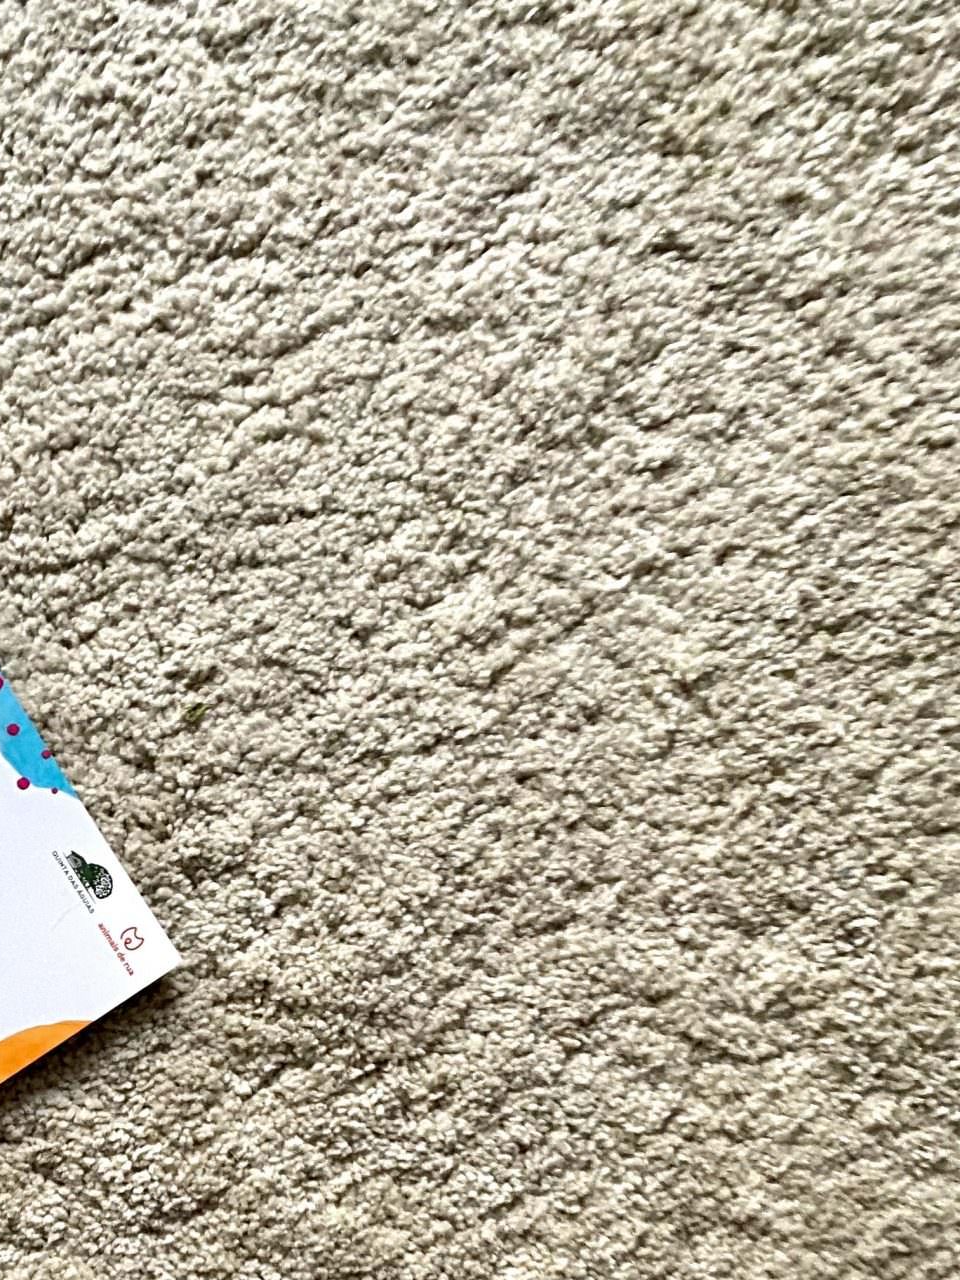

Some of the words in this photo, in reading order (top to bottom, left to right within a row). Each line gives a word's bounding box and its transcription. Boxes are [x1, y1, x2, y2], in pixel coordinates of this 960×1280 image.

[52, 850, 69, 877] QUINTA
[68, 875, 79, 890] DAS
[98, 922, 119, 952] animais
[117, 952, 126, 962] de
[123, 962, 135, 977] rua
